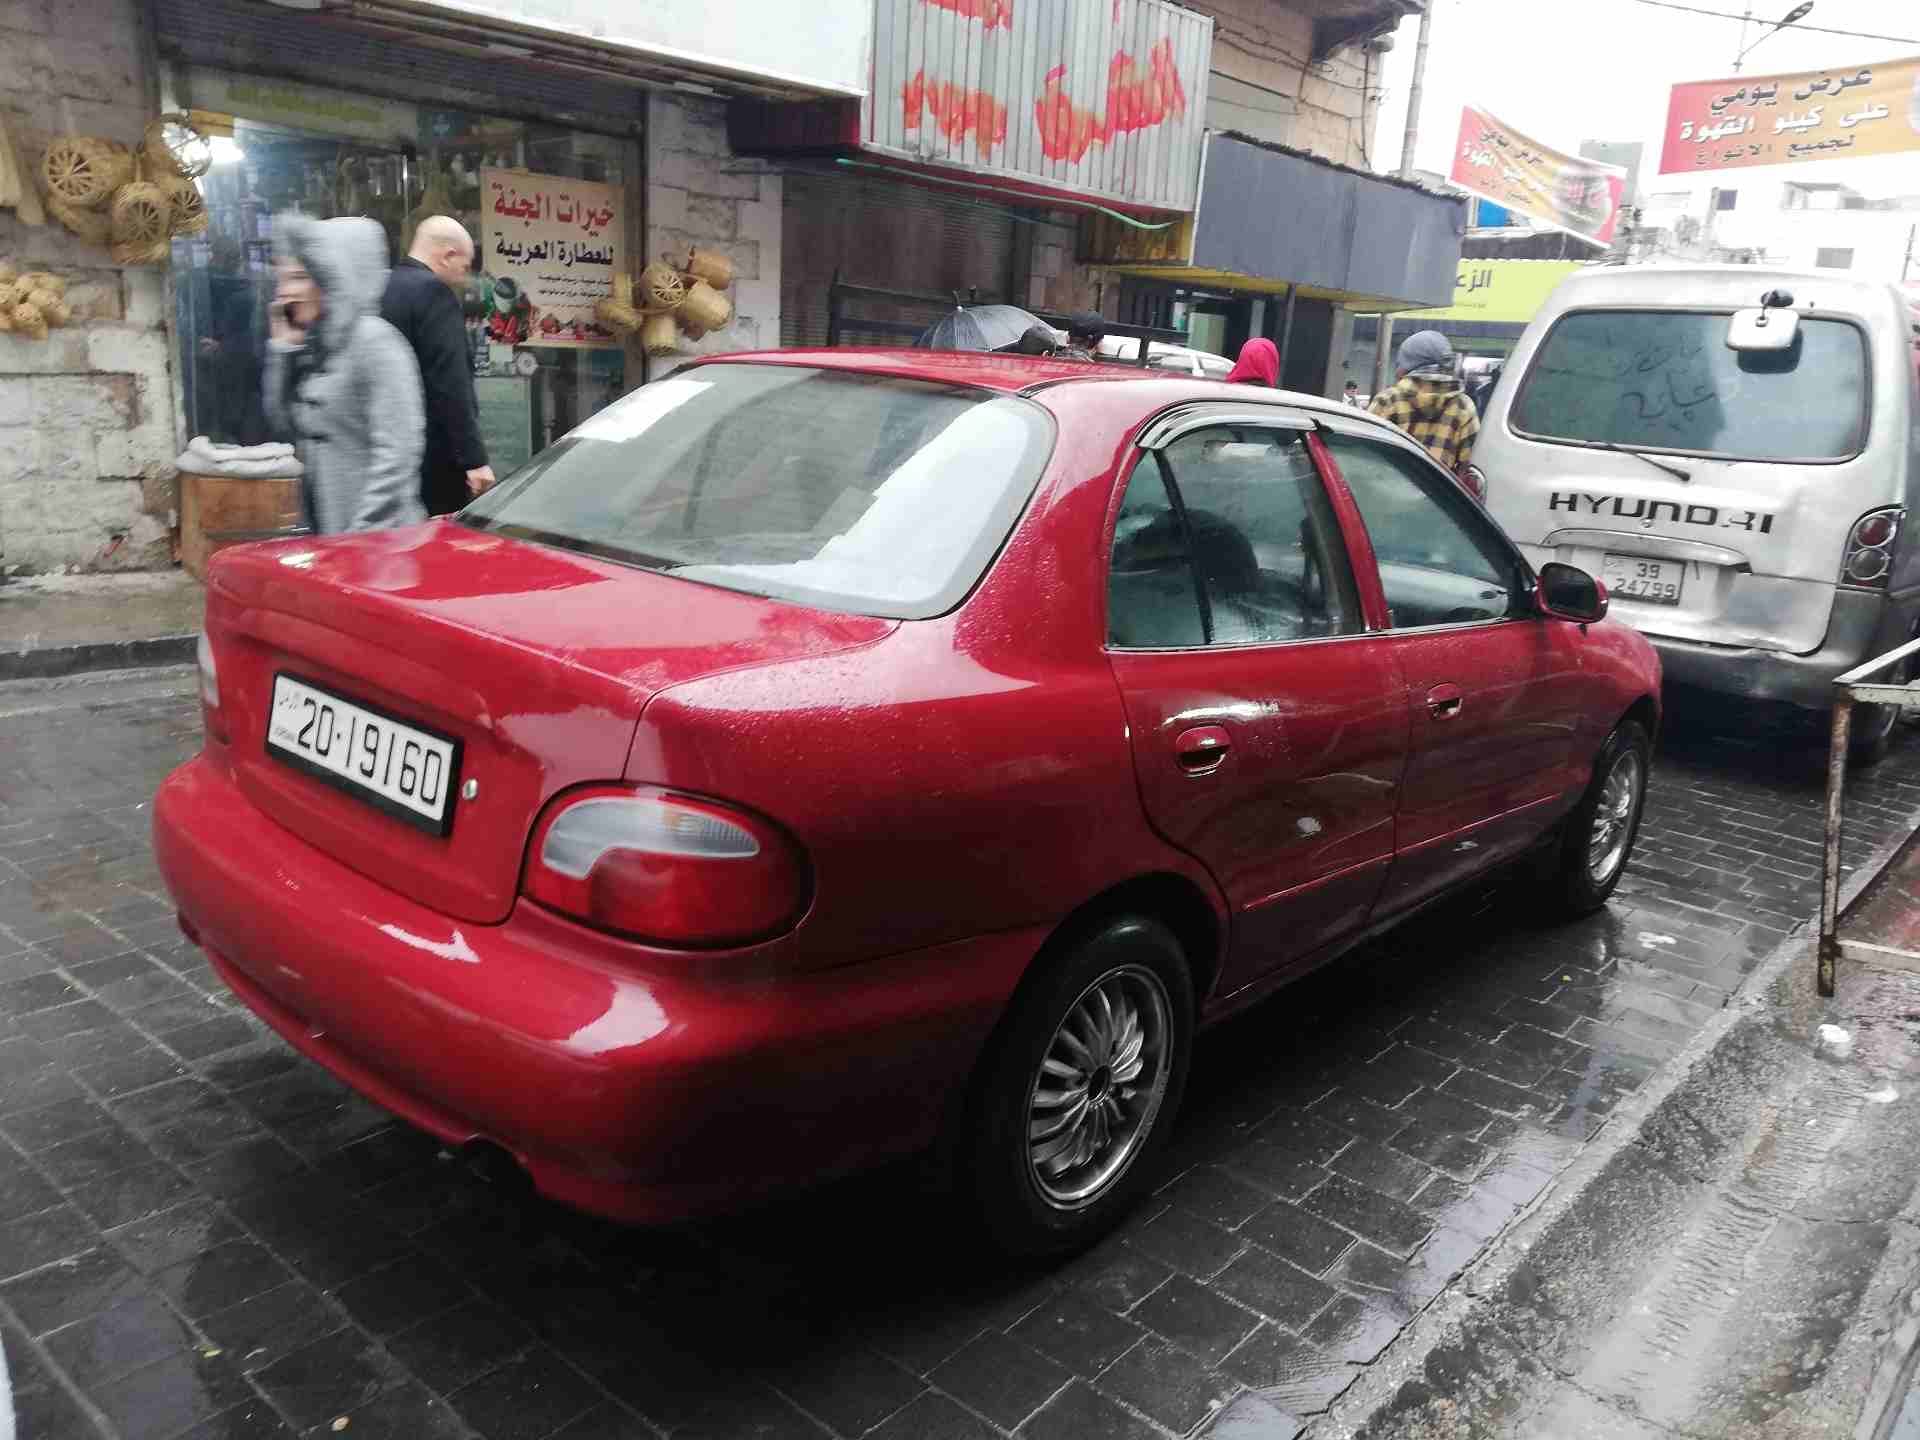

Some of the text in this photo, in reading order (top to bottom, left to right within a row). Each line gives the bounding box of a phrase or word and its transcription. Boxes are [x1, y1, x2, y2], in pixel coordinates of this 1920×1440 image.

[1711, 69, 1872, 115] عرض يومي
[1680, 103, 1889, 143] على كيلو القهوة
[1787, 134, 1857, 159] لجميع
[492, 182, 615, 237] خيرات الجنة
[494, 231, 614, 267] للعطارة العربية
[1614, 577, 1677, 599] 24799
[1636, 562, 1660, 579] 39
